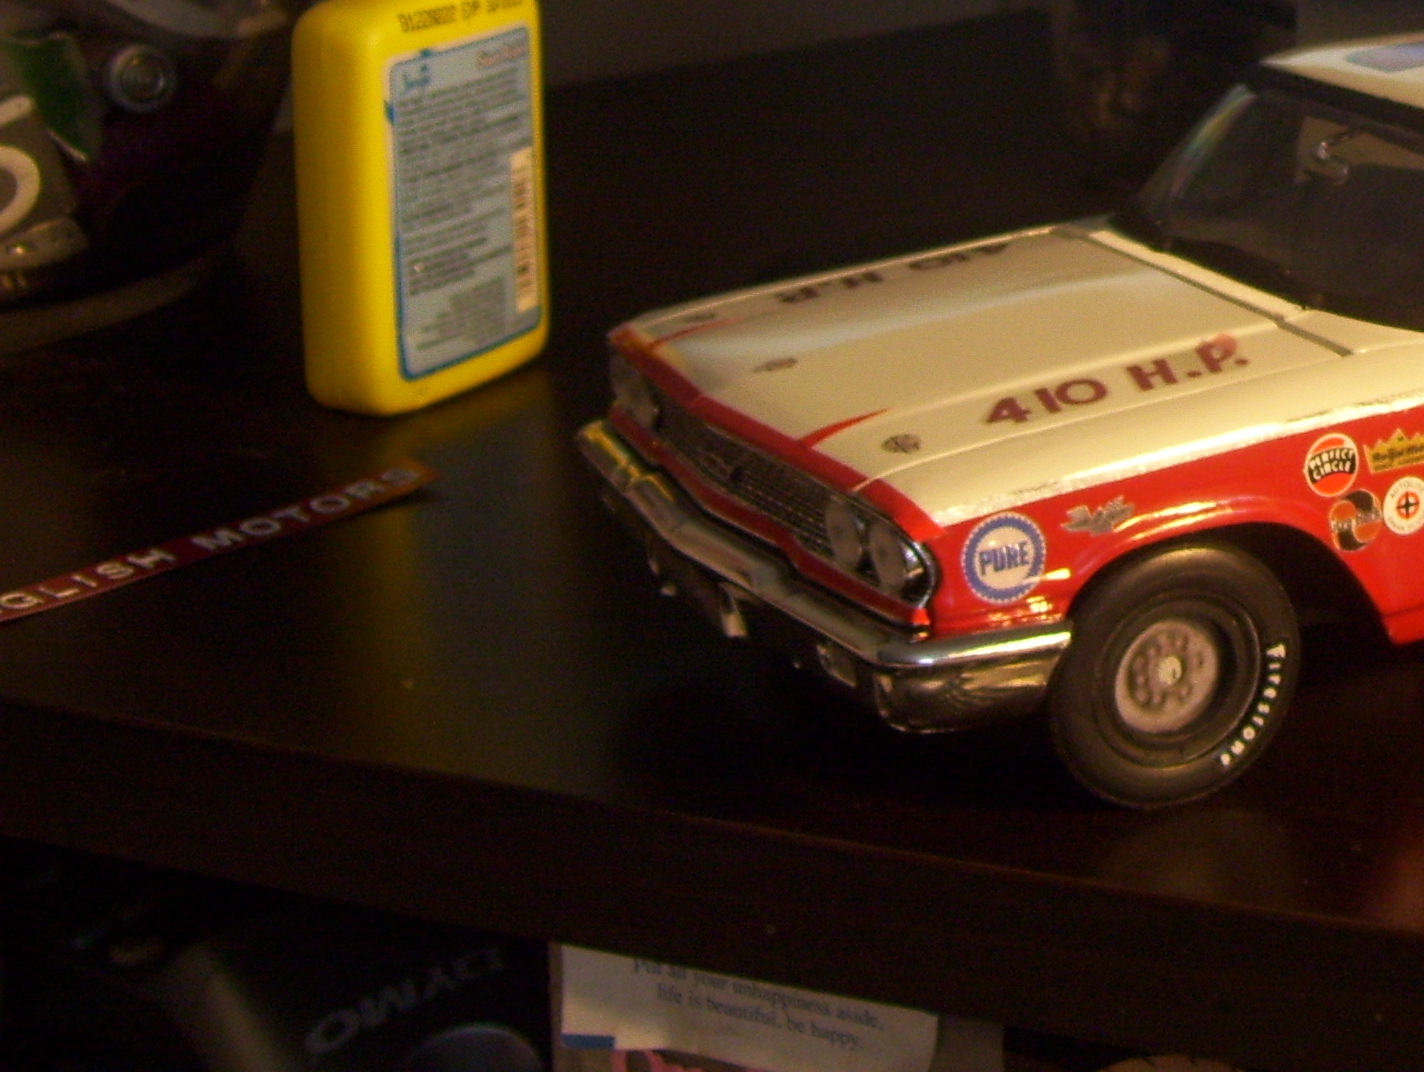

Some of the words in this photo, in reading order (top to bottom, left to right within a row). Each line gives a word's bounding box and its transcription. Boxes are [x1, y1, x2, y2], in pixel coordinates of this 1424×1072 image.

[982, 377, 1108, 427] 410
[1128, 333, 1249, 392] H.P.
[1308, 447, 1353, 471] PERFECT
[1312, 459, 1353, 481] CIRCLE
[0, 546, 176, 613] GLISH
[193, 467, 419, 552] MOTORS
[979, 542, 1030, 571] PURE
[656, 982, 684, 1005] life
[689, 992, 702, 1008] is
[786, 1016, 804, 1034] be
